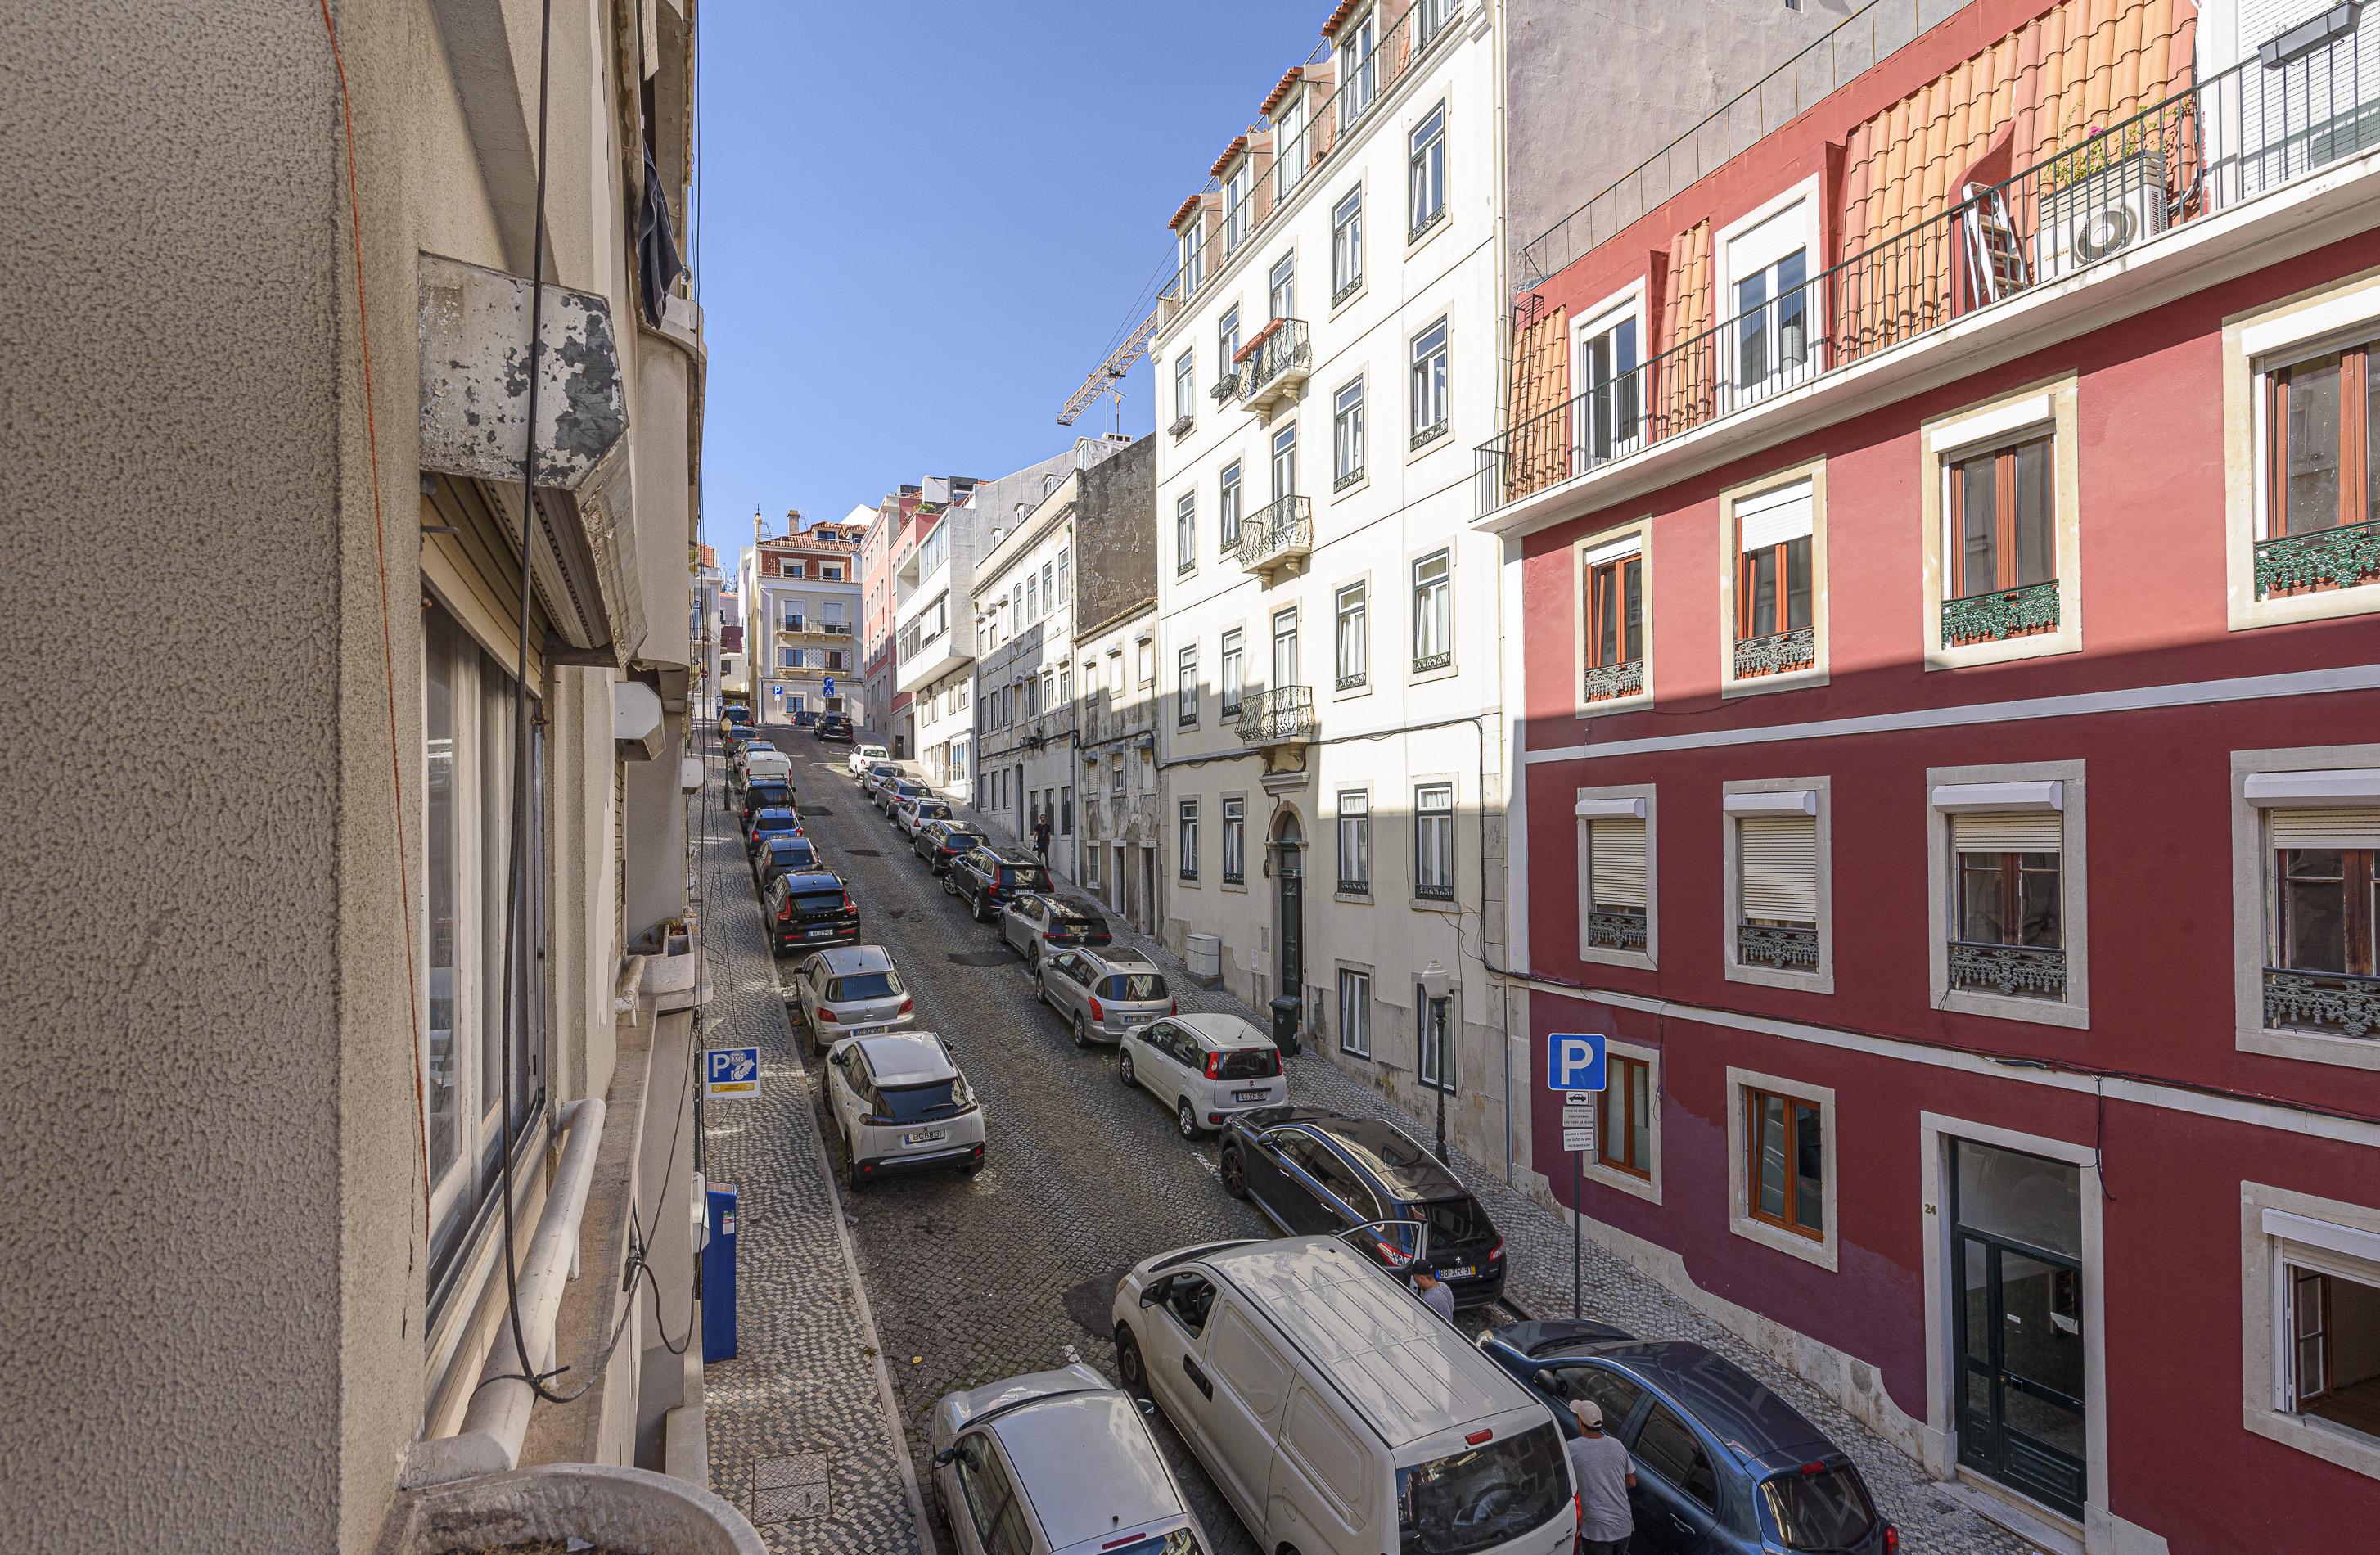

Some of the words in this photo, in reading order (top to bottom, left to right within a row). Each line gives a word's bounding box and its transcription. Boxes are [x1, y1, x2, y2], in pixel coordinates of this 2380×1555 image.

[713, 1054, 730, 1078] P
[1561, 1039, 1594, 1085] P
[1924, 1203, 1937, 1216] 24
